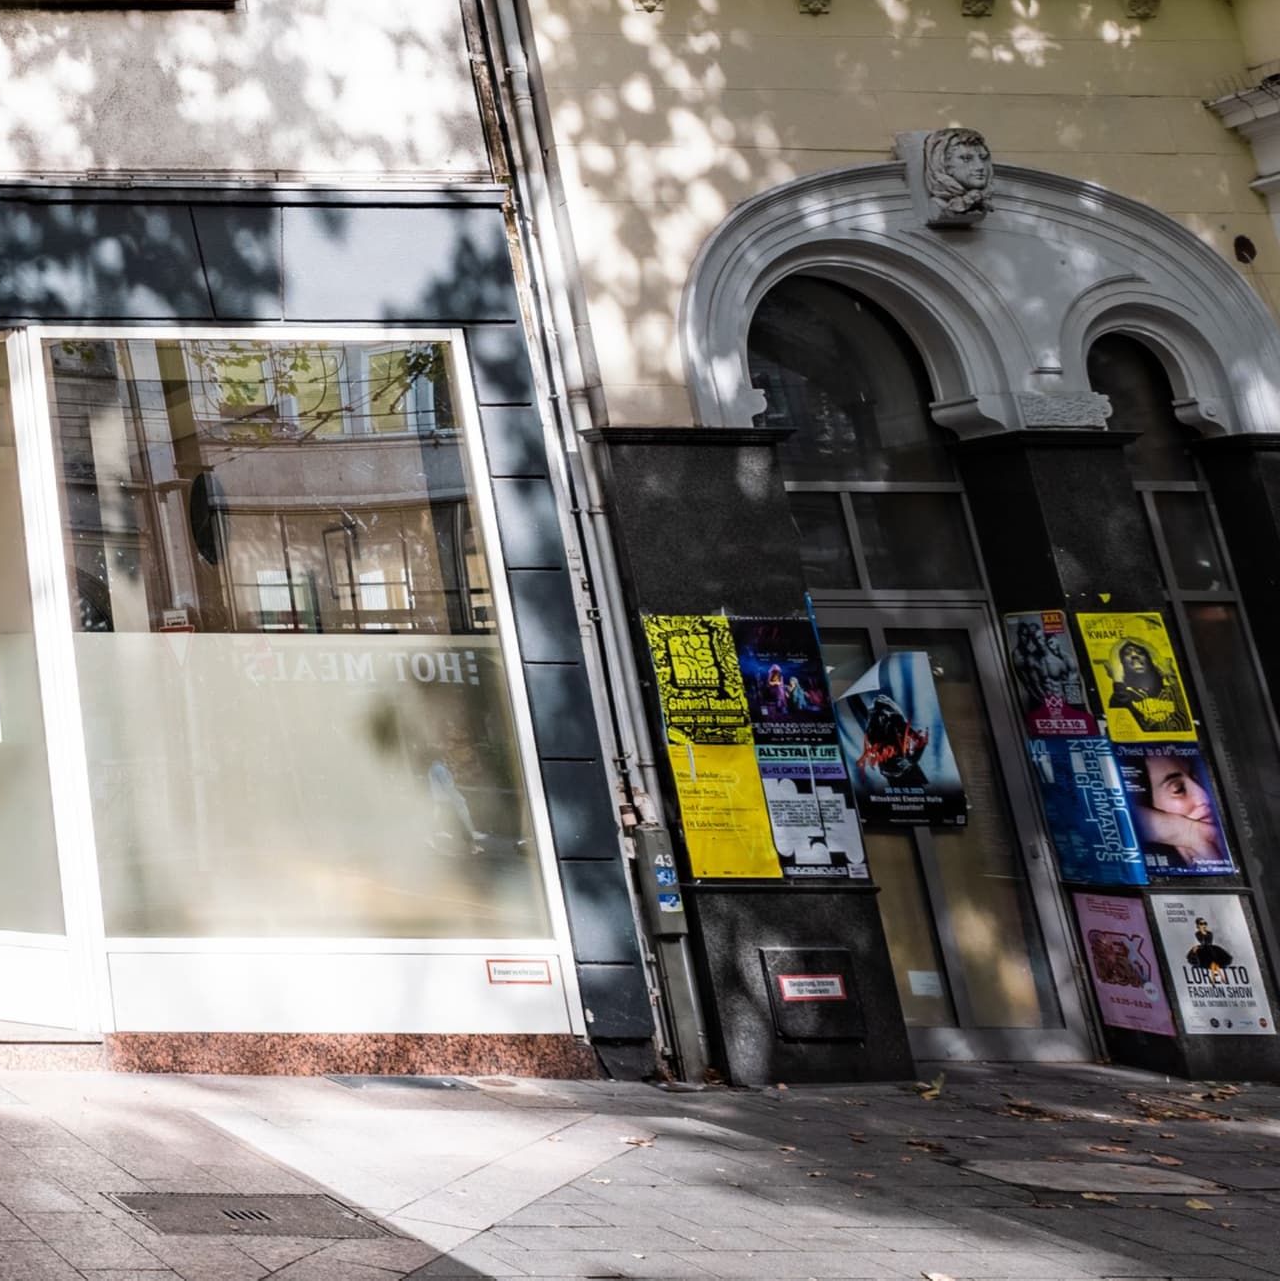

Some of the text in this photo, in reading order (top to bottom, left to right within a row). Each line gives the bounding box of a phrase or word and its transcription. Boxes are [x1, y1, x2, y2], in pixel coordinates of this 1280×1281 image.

[1080, 739, 1123, 862] PERFORMANCE
[654, 854, 673, 868] 43
[1188, 986, 1254, 999] FASHION SHOW
